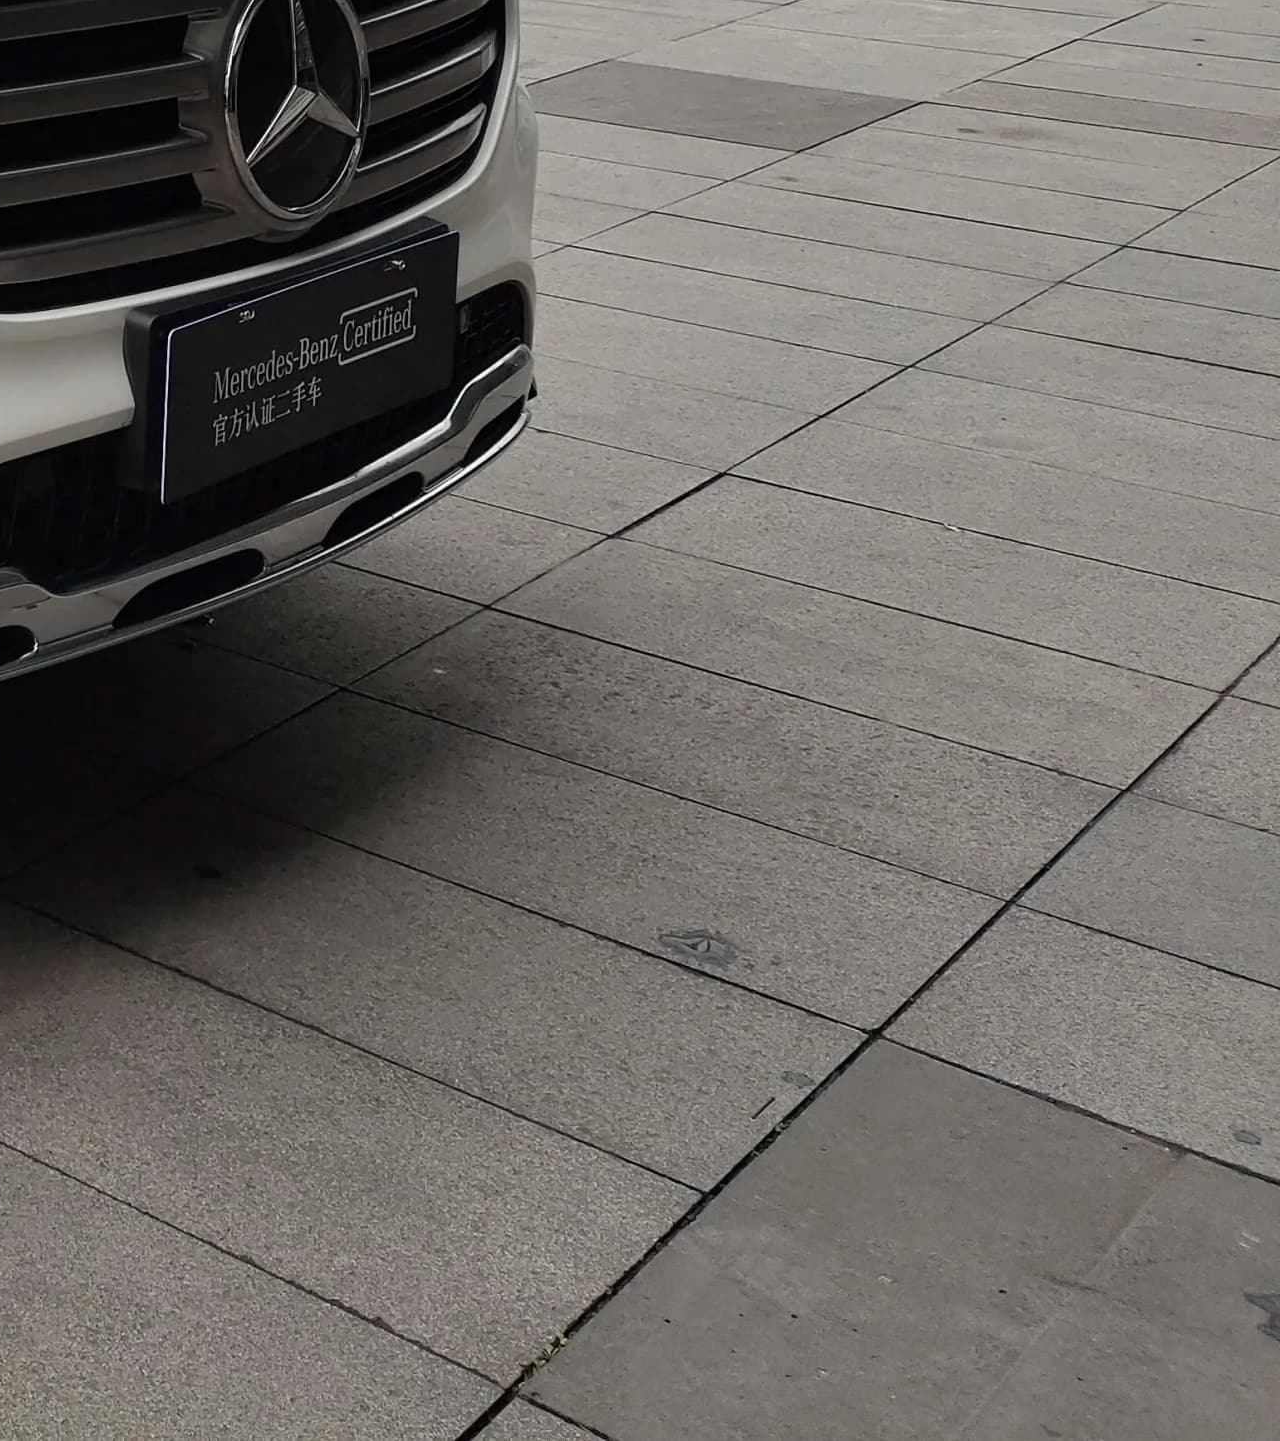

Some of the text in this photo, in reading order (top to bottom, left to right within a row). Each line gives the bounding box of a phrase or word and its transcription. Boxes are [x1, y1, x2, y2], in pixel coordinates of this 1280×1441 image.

[213, 300, 412, 404] Mercedes-Benz Certified
[213, 376, 322, 446] 官方认证二手车
